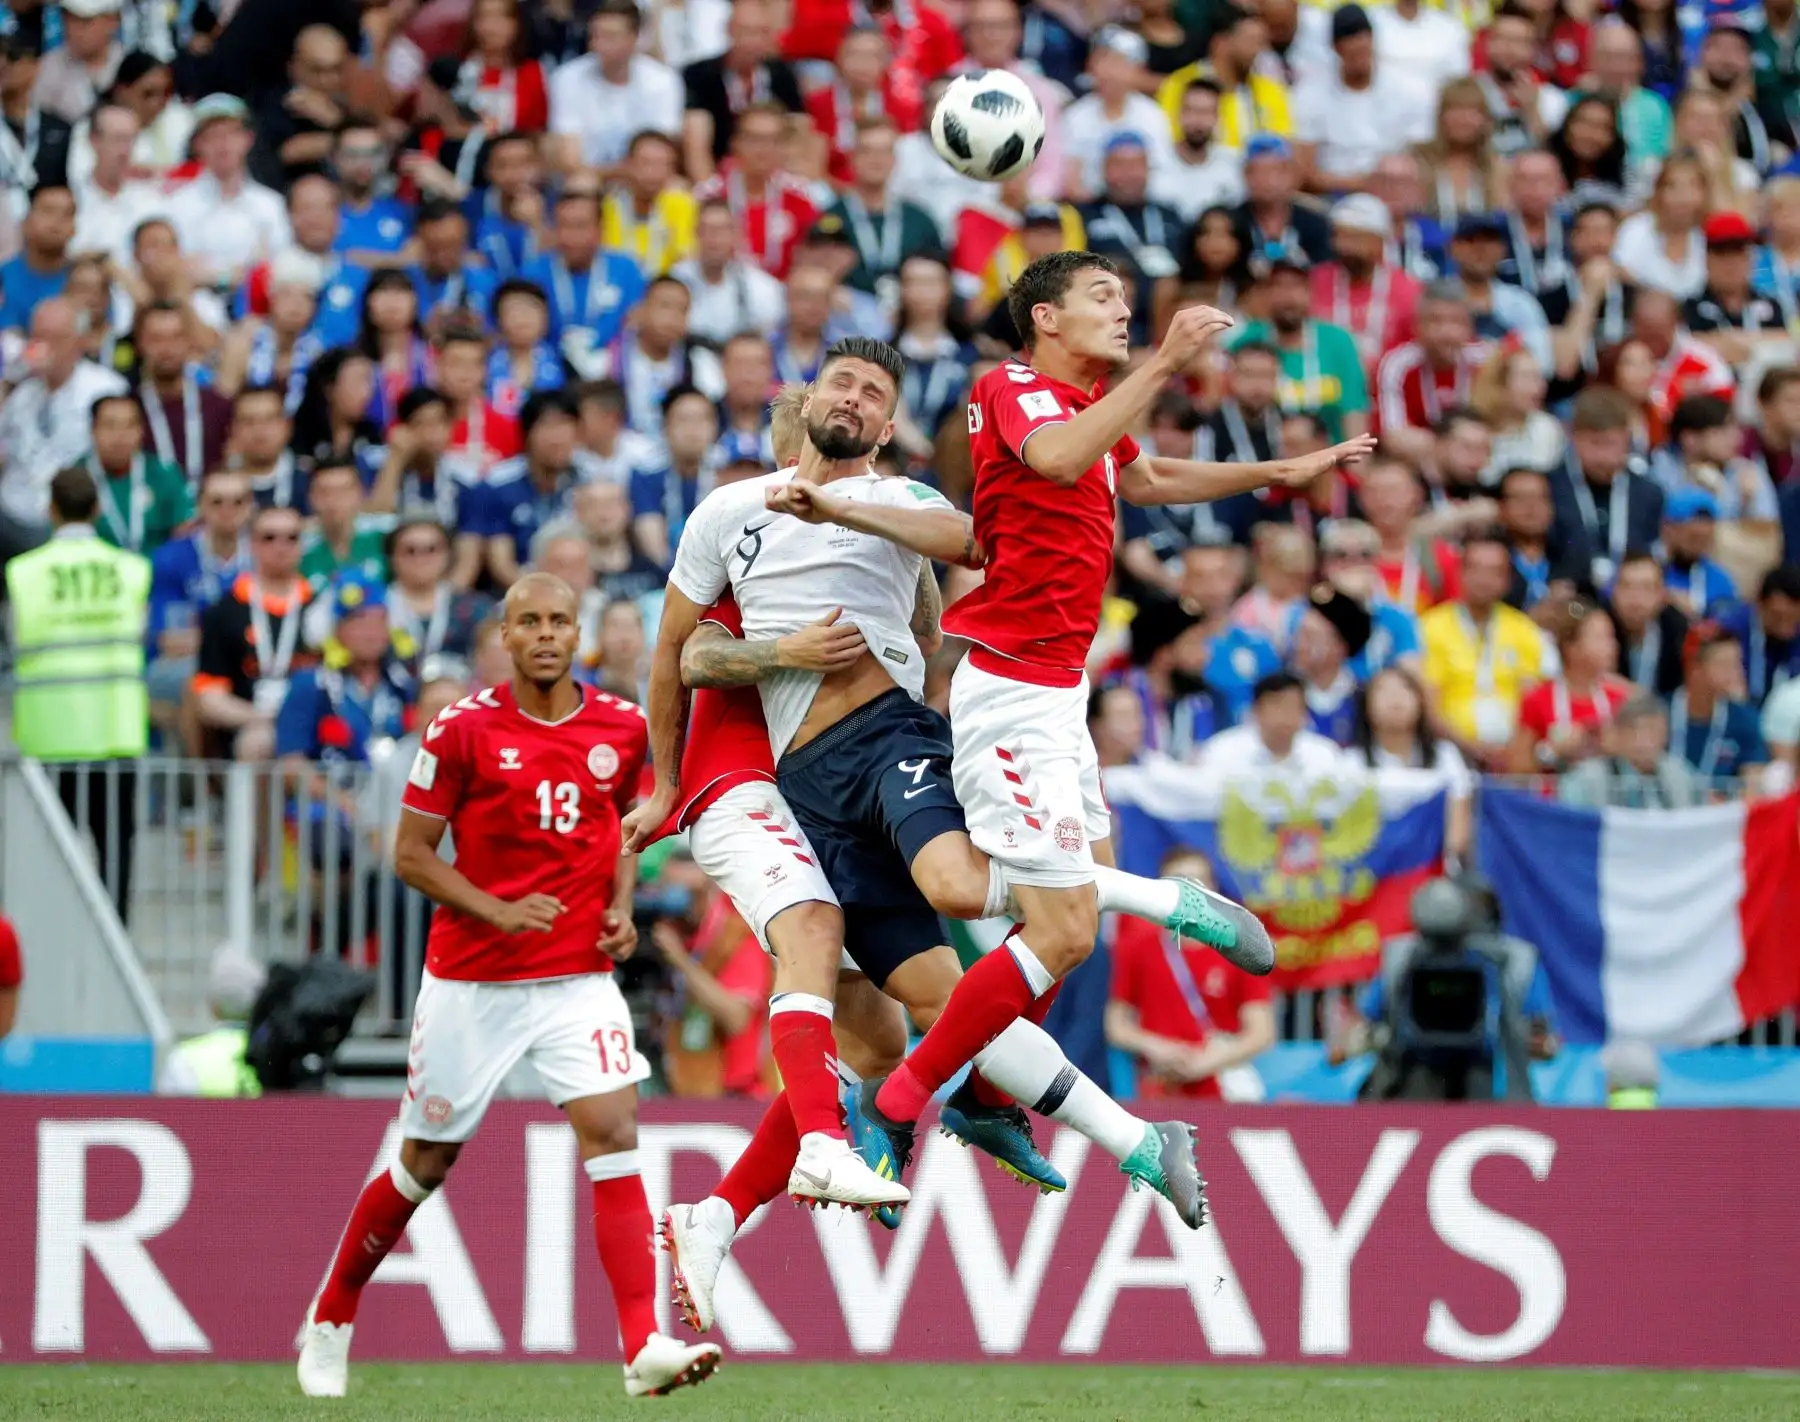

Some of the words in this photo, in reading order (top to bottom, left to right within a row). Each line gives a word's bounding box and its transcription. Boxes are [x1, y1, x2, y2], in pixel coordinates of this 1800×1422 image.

[735, 531, 762, 578] 9
[897, 758, 931, 785] 9
[535, 779, 581, 834] 13
[591, 1027, 631, 1075] 13
[294, 1118, 1568, 1363] AIRWAYS
